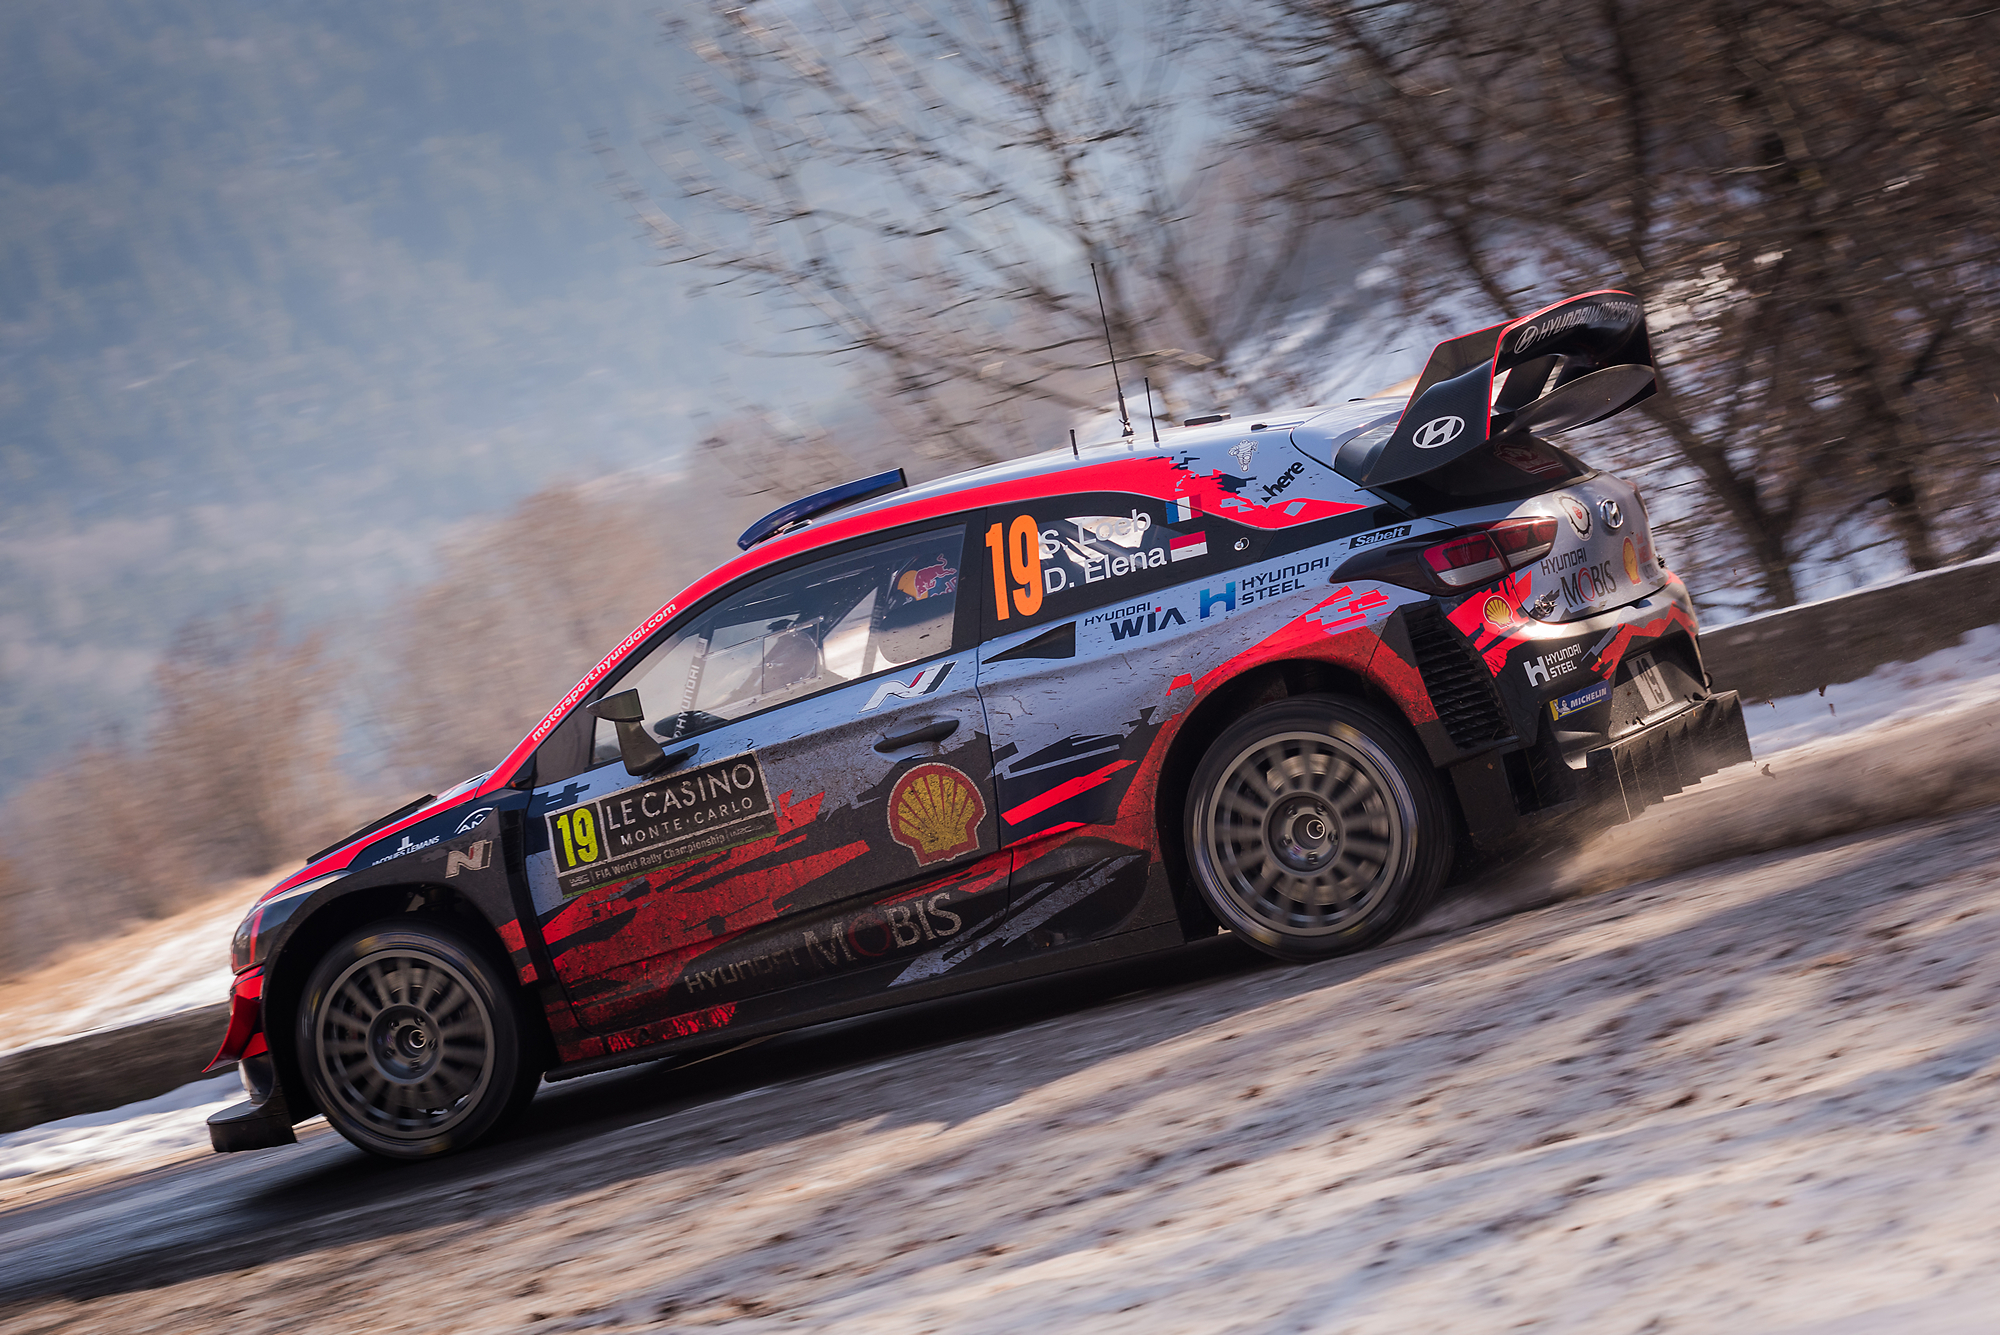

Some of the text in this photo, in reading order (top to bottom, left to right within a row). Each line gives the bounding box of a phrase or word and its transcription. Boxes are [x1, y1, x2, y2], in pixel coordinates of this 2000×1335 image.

[1537, 306, 1592, 342] HYUNDAI
[1262, 461, 1305, 497] here
[1040, 508, 1152, 555] S. Loeb
[1354, 526, 1406, 548] Sabelt
[985, 514, 1043, 621] 19
[1044, 546, 1168, 594] D. Elena
[1241, 556, 1330, 591] HYUNDAI
[1540, 547, 1588, 576] HYUNDAI
[1241, 579, 1305, 606] STEEL
[1559, 560, 1617, 608] MOBIS
[1084, 601, 1151, 627] HYUNDAI
[1110, 606, 1186, 641] WIA
[531, 603, 677, 742] motorsport.hyundai.com
[1544, 643, 1582, 666] HYUNDAI
[1550, 660, 1578, 678] STEEL
[675, 664, 700, 729] HYUNDAI
[1570, 687, 1607, 709] MICHELIN
[606, 763, 755, 830] LE CASINO
[556, 807, 599, 867] 19
[619, 797, 753, 846] MONTE CARLO
[406, 835, 441, 855] LEMANS
[595, 866, 612, 881] FIA
[612, 859, 639, 875] World
[640, 852, 663, 867] Rally
[663, 833, 726, 860] Championship
[684, 892, 963, 994] HYUNDAI MOBIS
